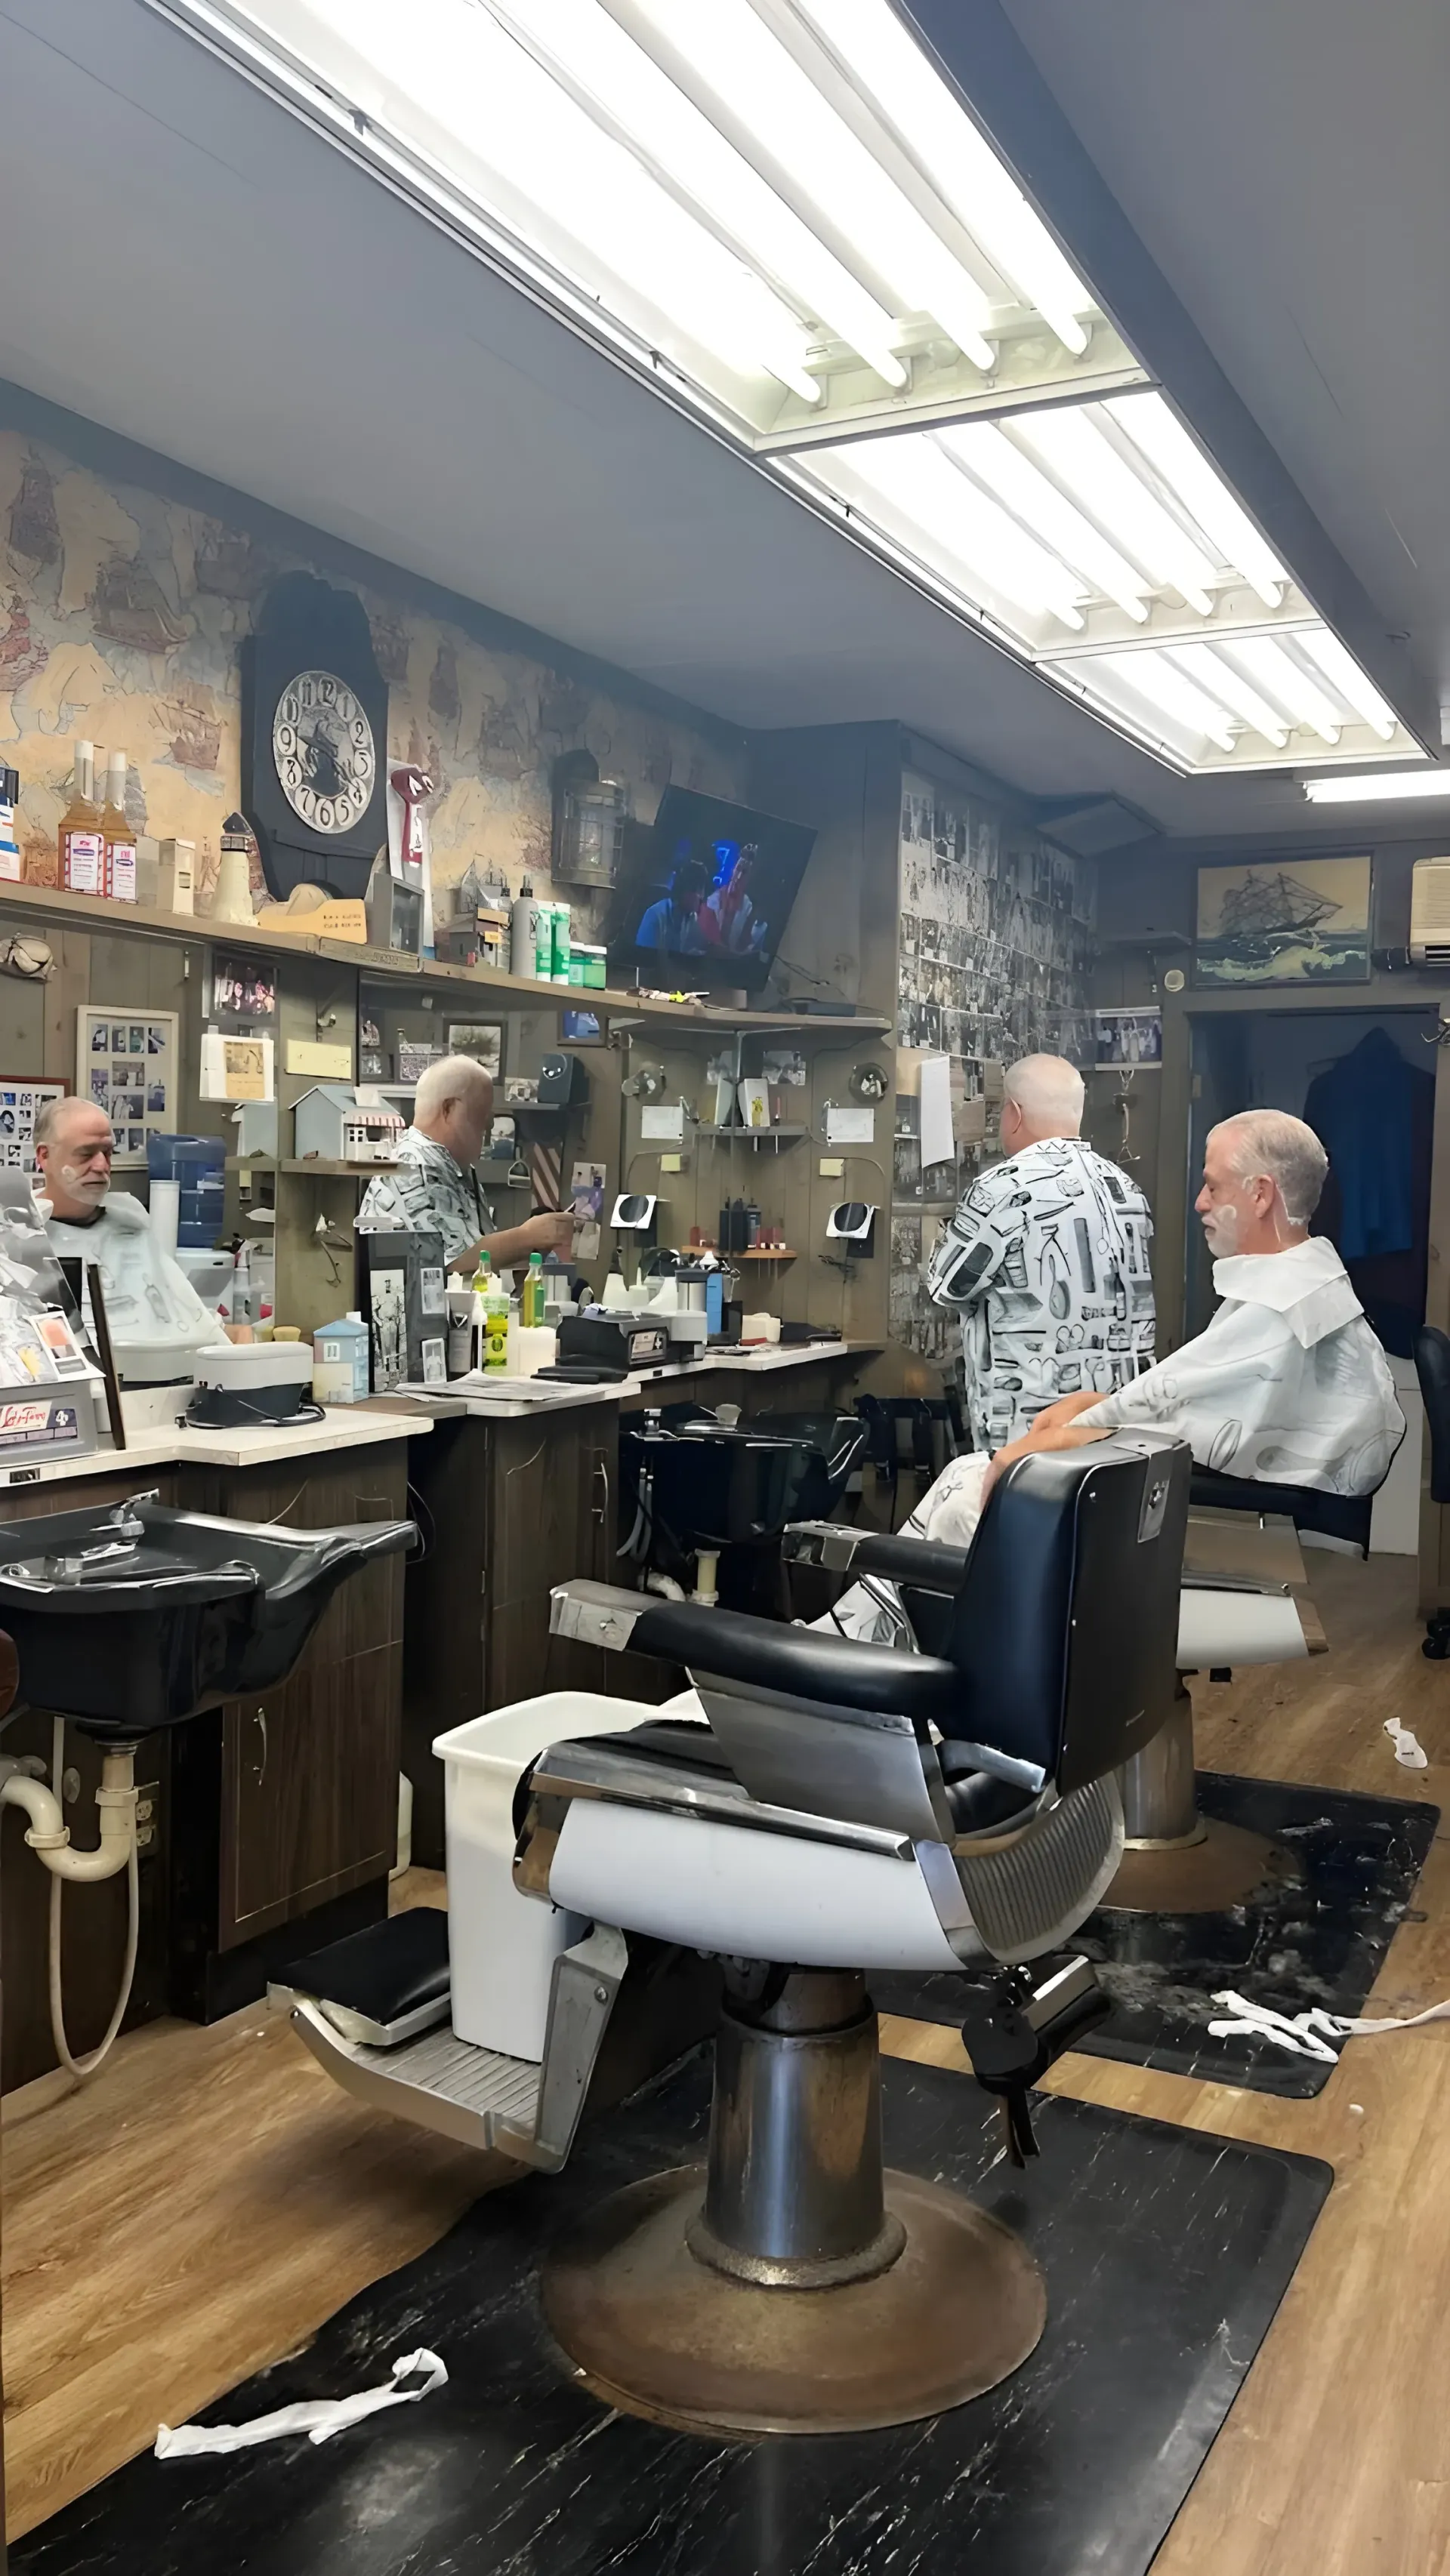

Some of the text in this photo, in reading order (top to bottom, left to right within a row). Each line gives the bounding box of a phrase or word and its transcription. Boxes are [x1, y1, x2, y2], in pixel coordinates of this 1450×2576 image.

[280, 726, 292, 752] 9
[355, 720, 364, 744] 2
[301, 787, 311, 813] 7
[319, 799, 331, 826] 6
[340, 798, 350, 823] 5
